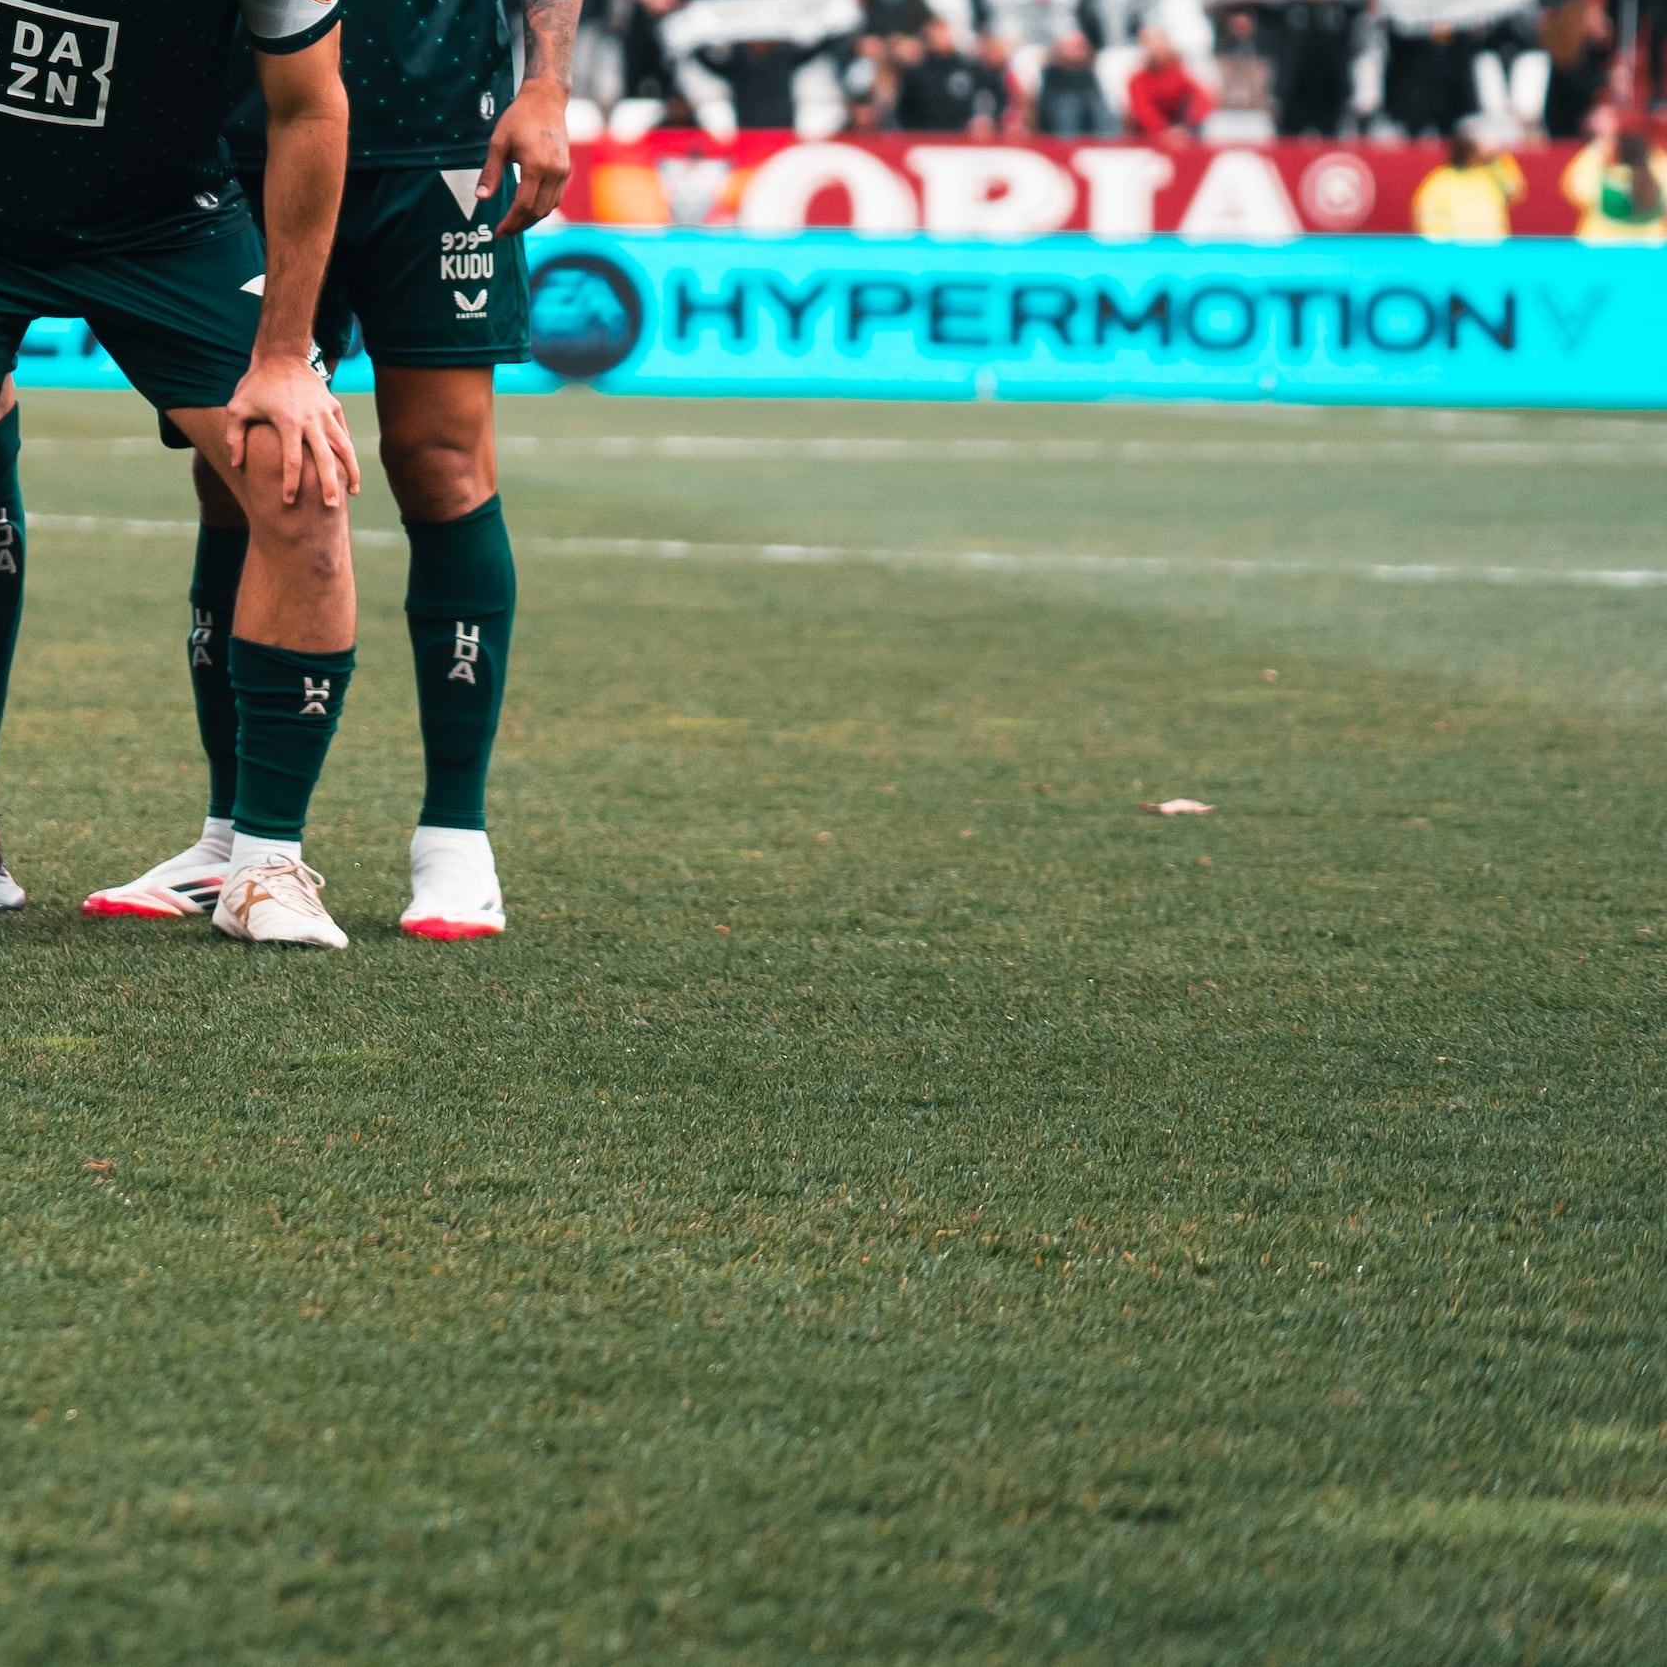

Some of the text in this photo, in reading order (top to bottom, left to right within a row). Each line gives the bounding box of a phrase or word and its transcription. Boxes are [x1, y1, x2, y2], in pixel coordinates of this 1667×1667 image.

[13, 19, 83, 68] DA
[6, 62, 78, 107] ZN
[441, 253, 494, 280] KUDU
[674, 280, 1517, 353] HYPERMOTION
[192, 608, 212, 666] UDA
[449, 621, 479, 685] UDA
[300, 677, 329, 715] UDA
